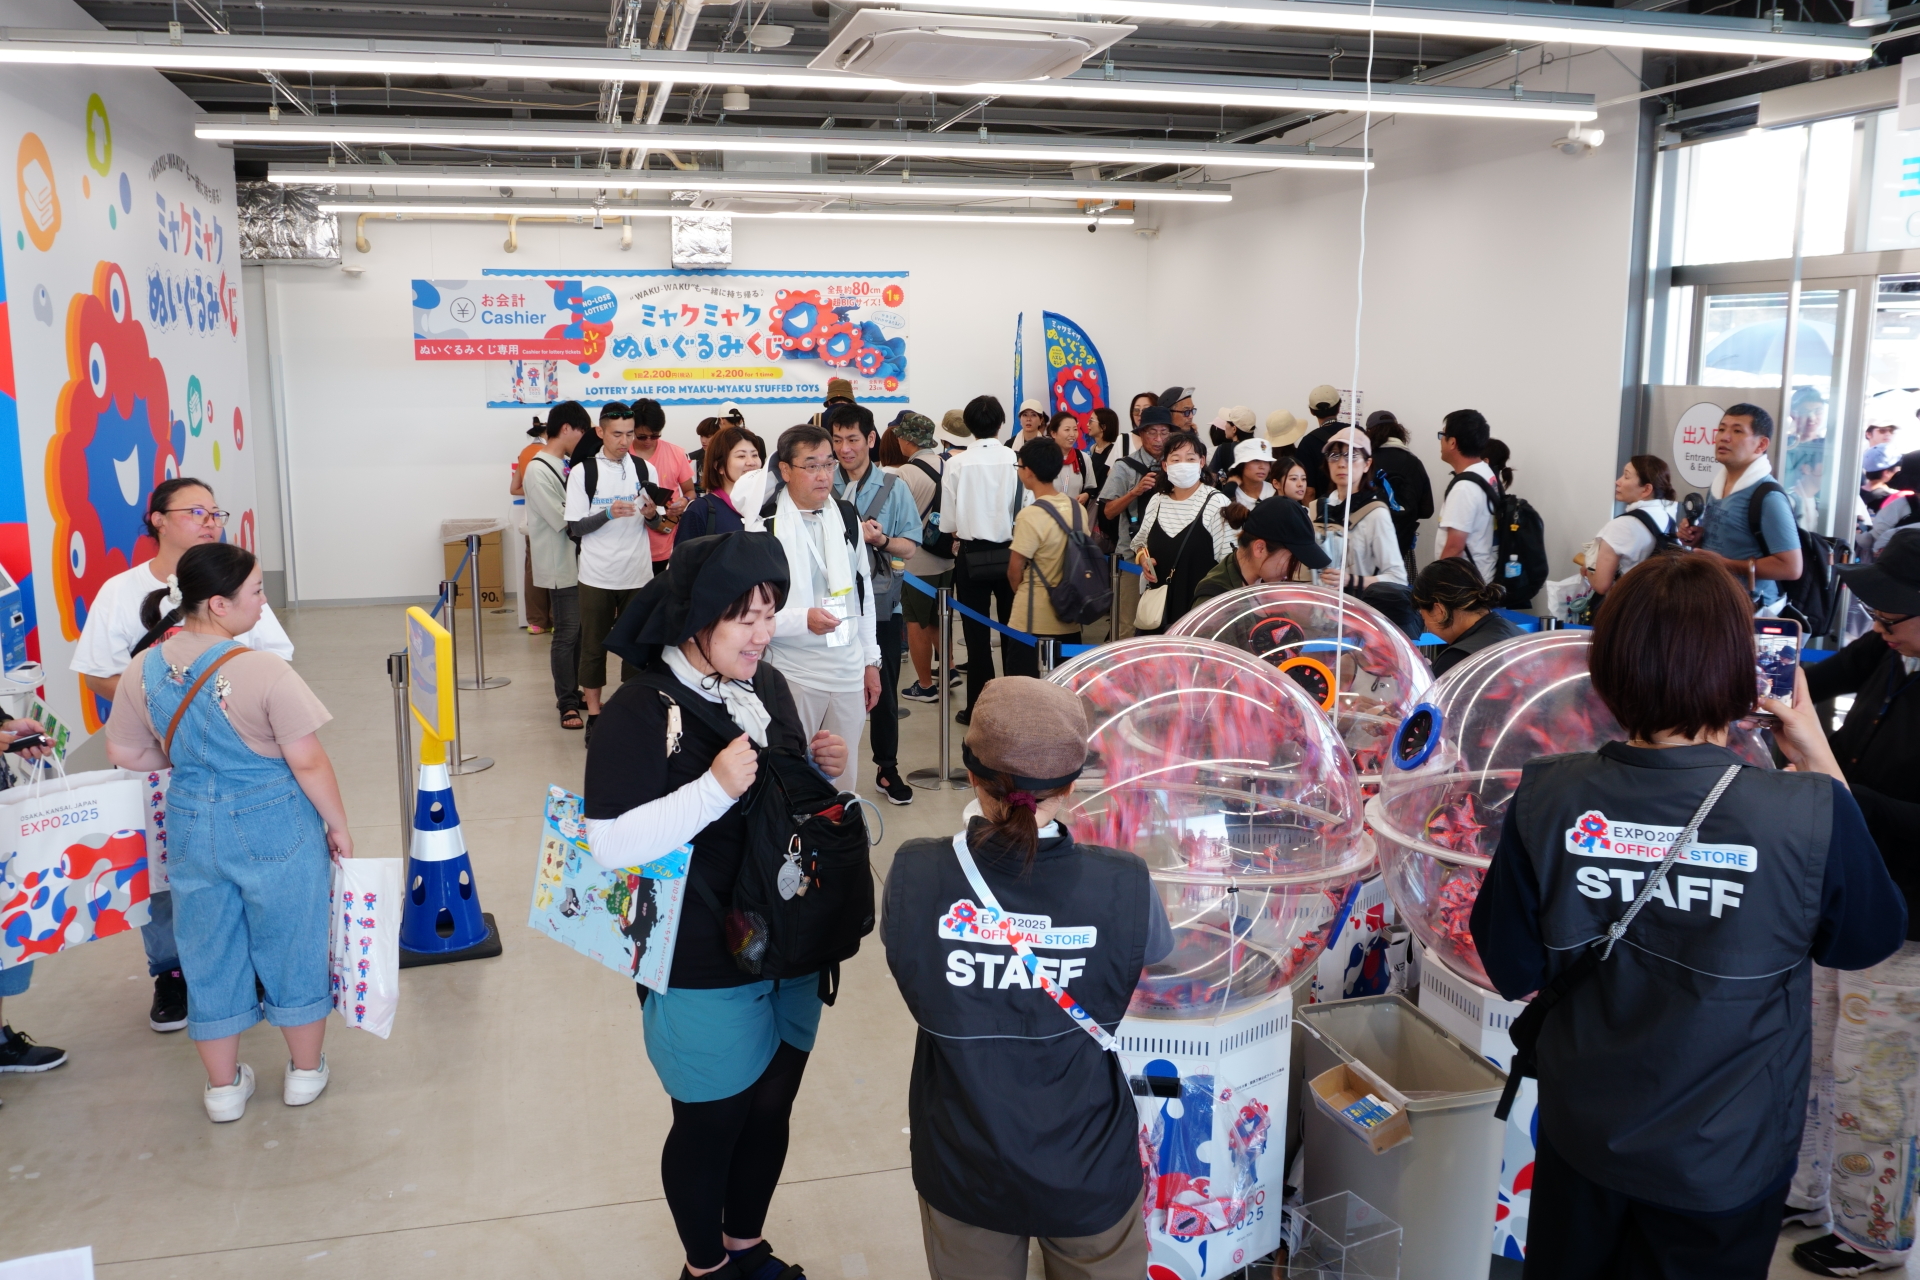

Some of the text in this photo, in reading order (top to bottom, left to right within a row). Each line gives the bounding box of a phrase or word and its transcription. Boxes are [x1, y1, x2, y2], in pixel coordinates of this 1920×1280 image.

[156, 191, 223, 265] ミャクミャク
[148, 269, 238, 338] ぬいぐるみくじ
[481, 293, 526, 308] お会計
[582, 293, 612, 308] NO-LOSE
[584, 301, 615, 317] LOTTERY!
[641, 303, 762, 328] ミャクミャク
[481, 310, 547, 325] Cashier
[1051, 320, 1081, 341] ミャクミャク
[419, 344, 519, 356] ぬいぐるみくじ専用
[612, 331, 785, 361] ぬいぐるみくじ
[1046, 328, 1097, 365] ぬいぐるみ
[585, 383, 820, 395] LOTTERY SALE FOR MYAKU-MYAKU STUFFED TOYS
[1698, 463, 1712, 472] Exit
[74, 799, 98, 809] JAPAN
[1614, 843, 1749, 867] OFFICIL STORE
[1576, 866, 1744, 919] STAFF
[981, 914, 1047, 930] EXO2025
[1044, 934, 1090, 945] STORE
